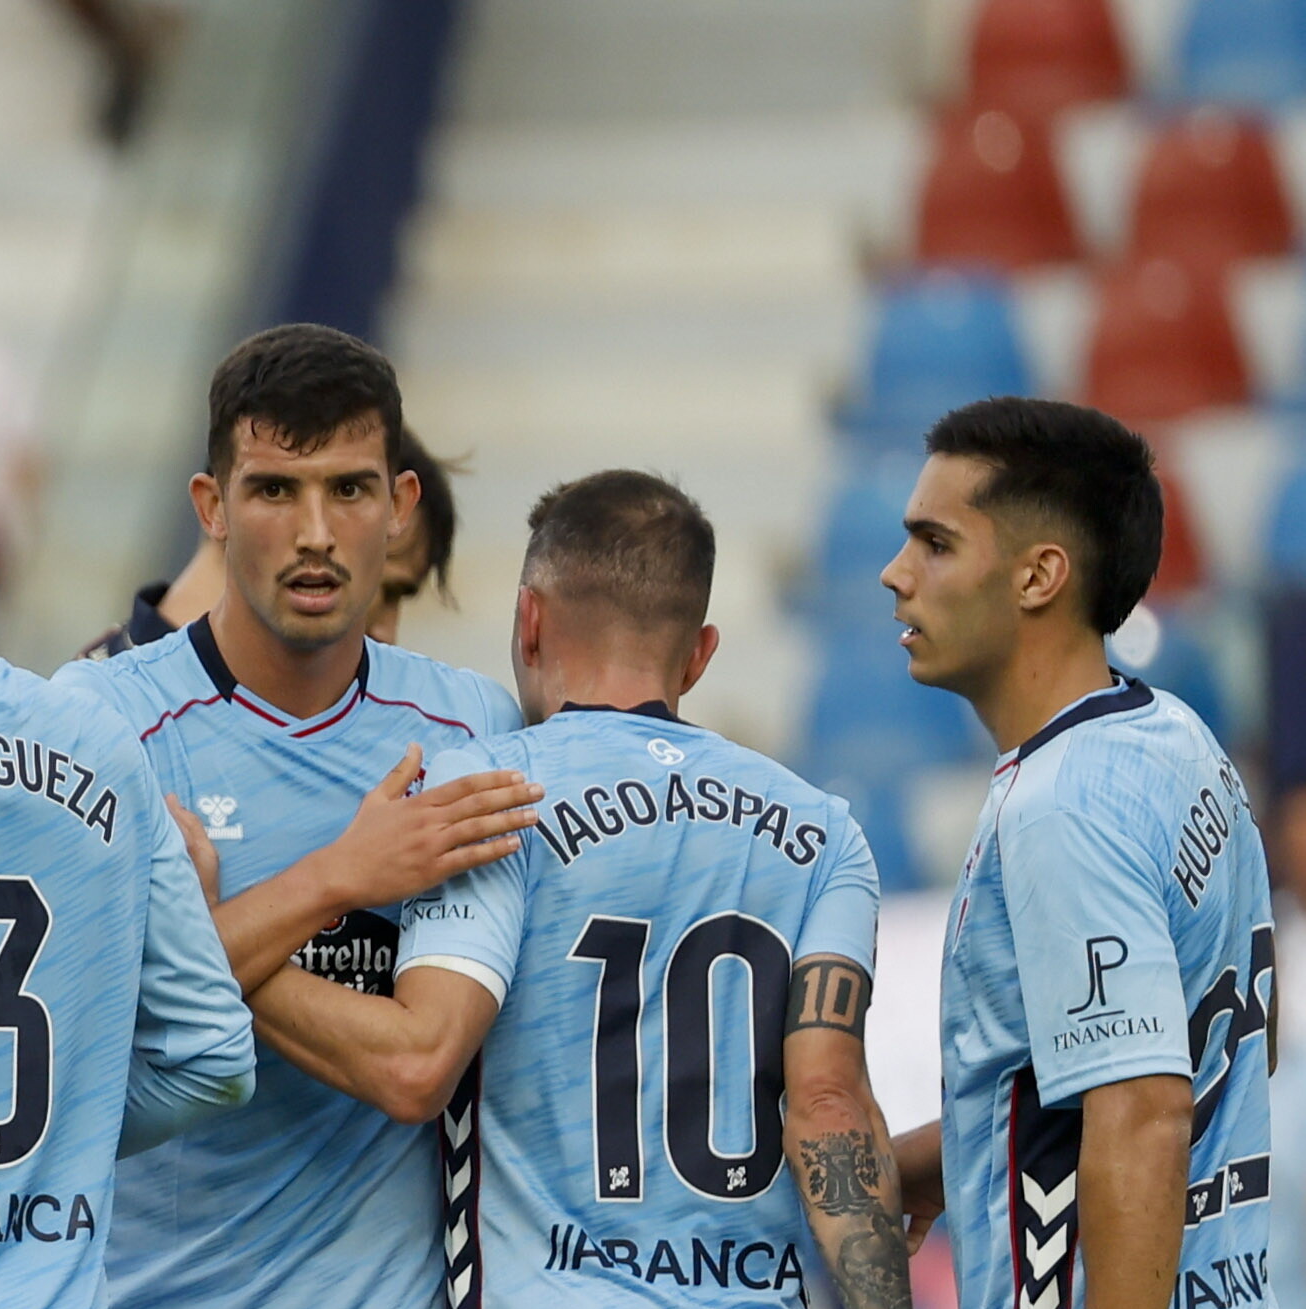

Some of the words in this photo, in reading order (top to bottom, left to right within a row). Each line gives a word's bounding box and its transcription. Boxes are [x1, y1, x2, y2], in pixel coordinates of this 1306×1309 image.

[665, 770, 827, 866] ASPAS
[1171, 786, 1229, 911] HUGO
[798, 966, 861, 1027] 10
[1052, 1017, 1165, 1053] FINANCIAL
[566, 911, 790, 1202] 10
